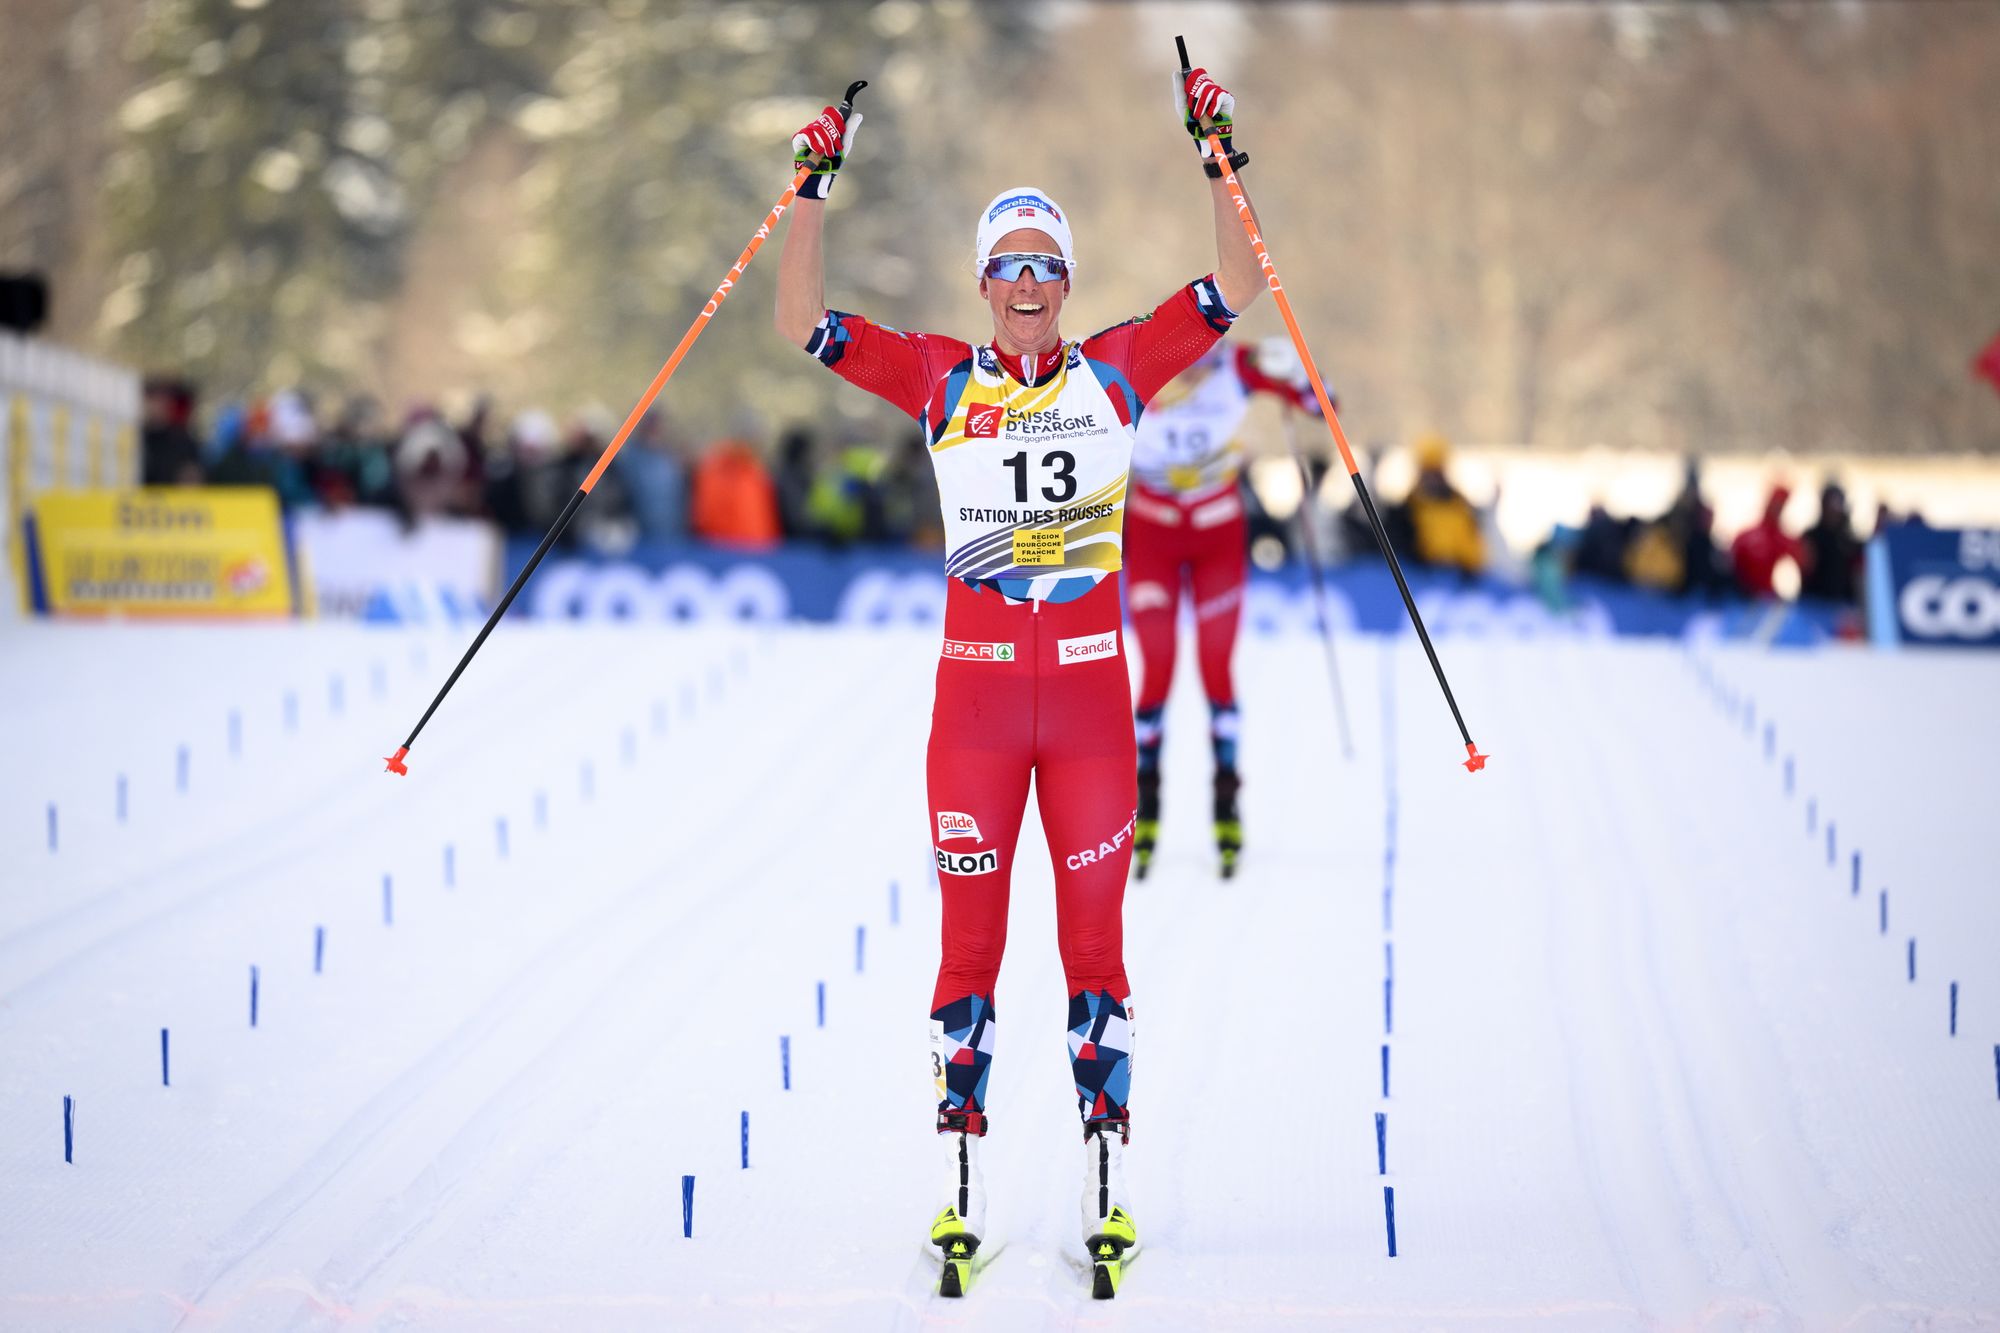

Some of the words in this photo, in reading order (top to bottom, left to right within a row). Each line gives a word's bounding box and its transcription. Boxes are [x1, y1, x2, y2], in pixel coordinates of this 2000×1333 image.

[819, 116, 839, 140] ESTRA
[989, 197, 1048, 220] SpareBank
[1006, 407, 1062, 424] CAISSE
[1005, 433, 1050, 443] Bourgogne
[1052, 427, 1109, 441] Franche-Comté
[1003, 450, 1078, 503] 13
[959, 507, 1018, 523] STATION
[1023, 510, 1054, 523] DES
[1059, 503, 1114, 522] ROUSSES
[944, 643, 994, 657] SPAR
[1065, 639, 1113, 658] Scandic
[939, 814, 974, 830] Gilde
[1066, 819, 1133, 871] CRAFT
